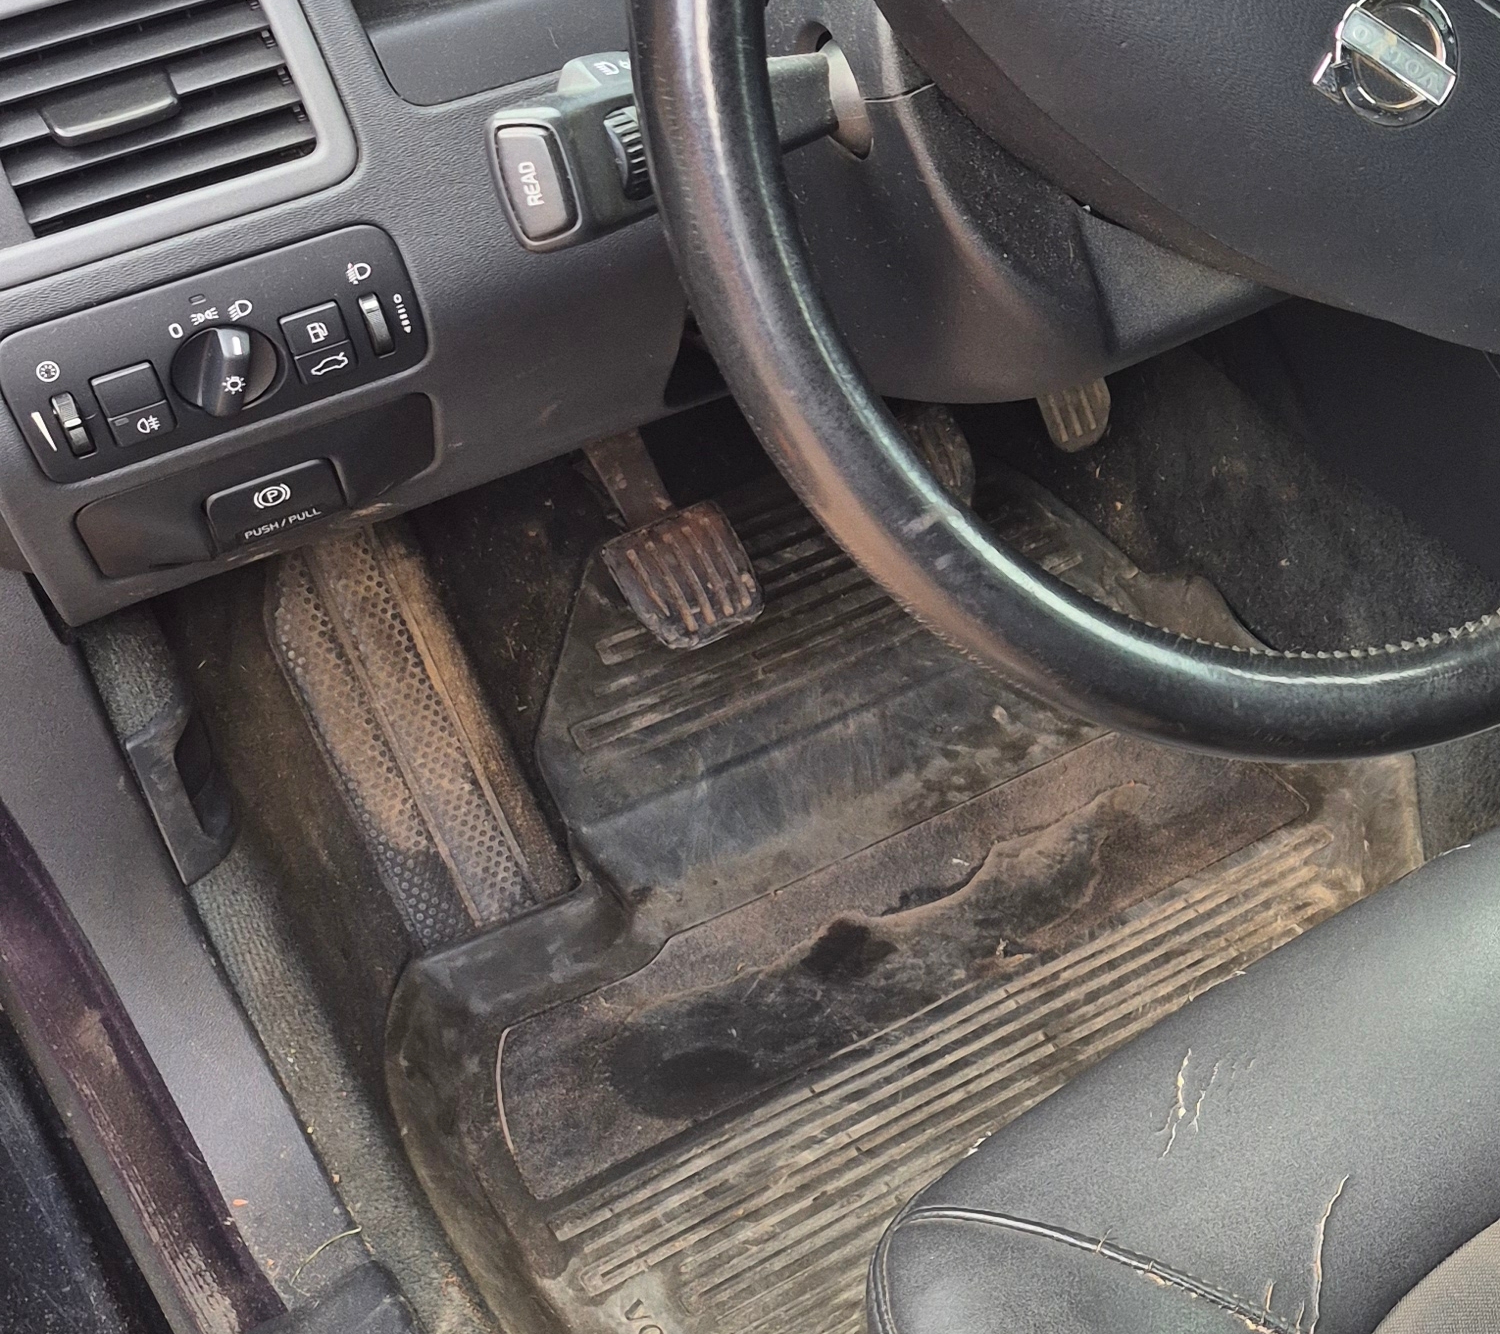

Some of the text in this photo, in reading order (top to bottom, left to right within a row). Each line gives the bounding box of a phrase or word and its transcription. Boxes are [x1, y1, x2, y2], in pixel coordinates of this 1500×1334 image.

[517, 162, 545, 207] READ
[244, 520, 281, 540] PUSH
[287, 506, 322, 524] PULL
